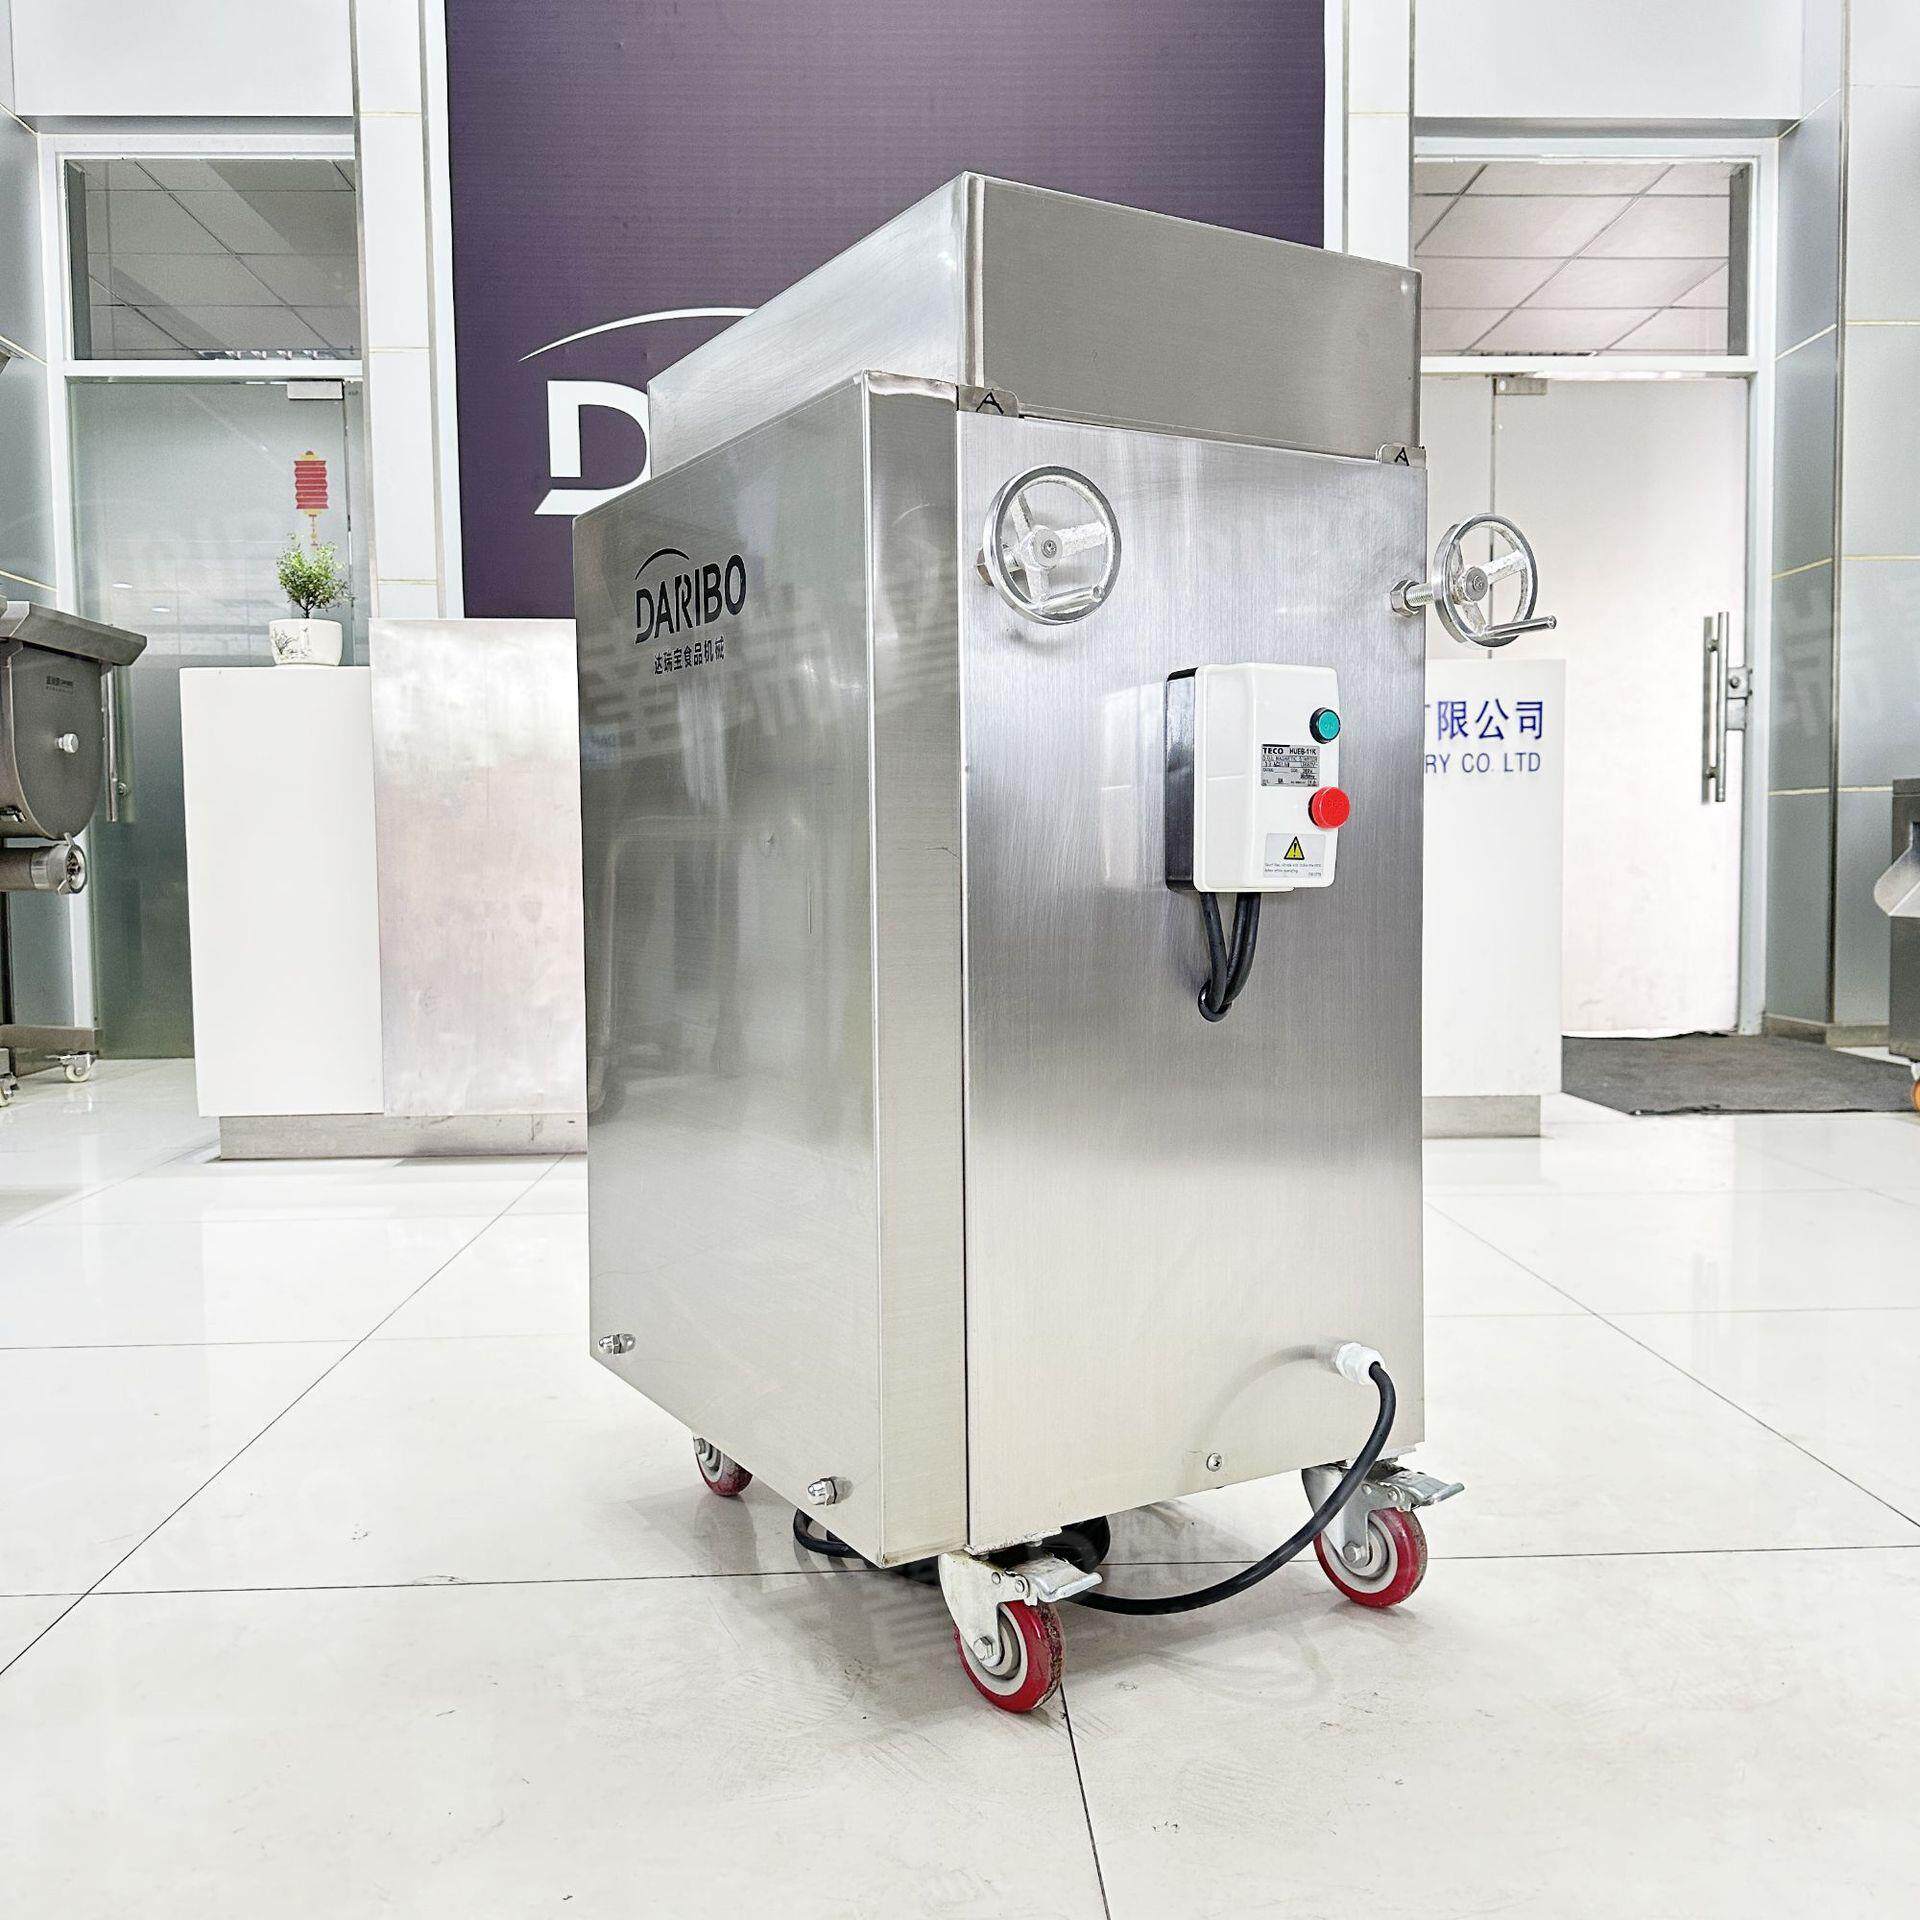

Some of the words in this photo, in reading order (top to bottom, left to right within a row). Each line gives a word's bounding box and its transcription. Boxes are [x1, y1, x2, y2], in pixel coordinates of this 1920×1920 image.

[975, 390, 1005, 415] A
[1394, 446, 1410, 467] A
[635, 554, 747, 644] DARIBO
[654, 635, 725, 675] 达瑞宝食品机械
[1424, 698, 1544, 741] 限公司
[1262, 747, 1284, 755] TECO
[1503, 753, 1541, 773] LTD
